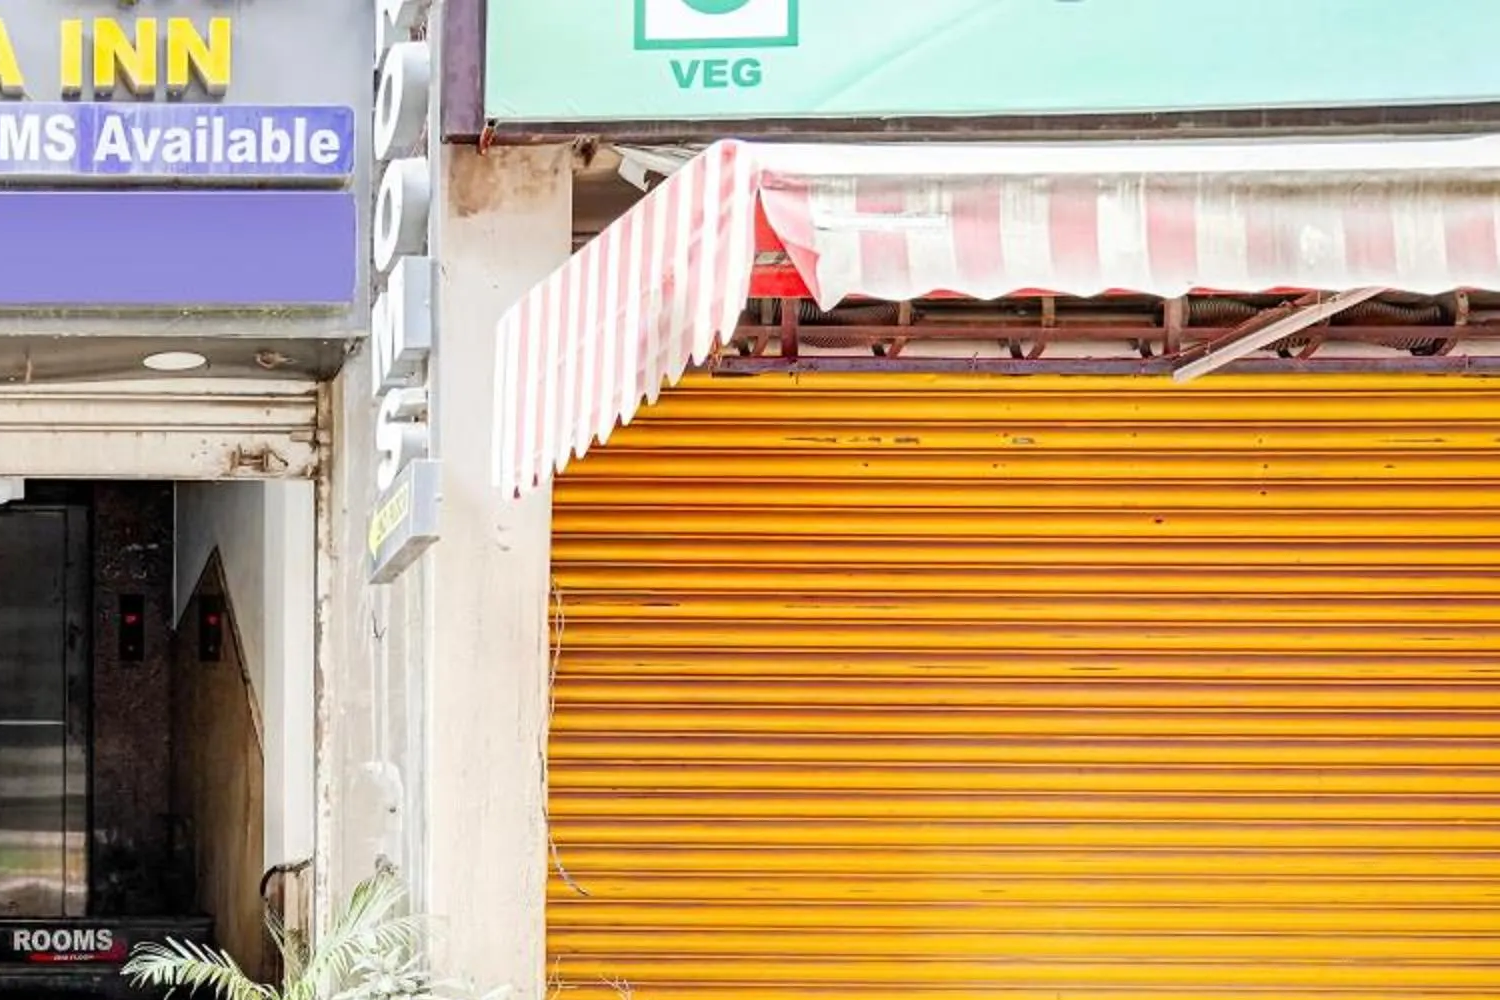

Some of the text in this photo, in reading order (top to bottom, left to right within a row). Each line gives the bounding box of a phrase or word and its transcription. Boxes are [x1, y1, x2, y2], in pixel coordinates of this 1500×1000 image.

[61, 16, 232, 87] INN
[670, 57, 762, 89] VEG
[94, 116, 340, 164] Available
[12, 928, 114, 952] ROOMS
